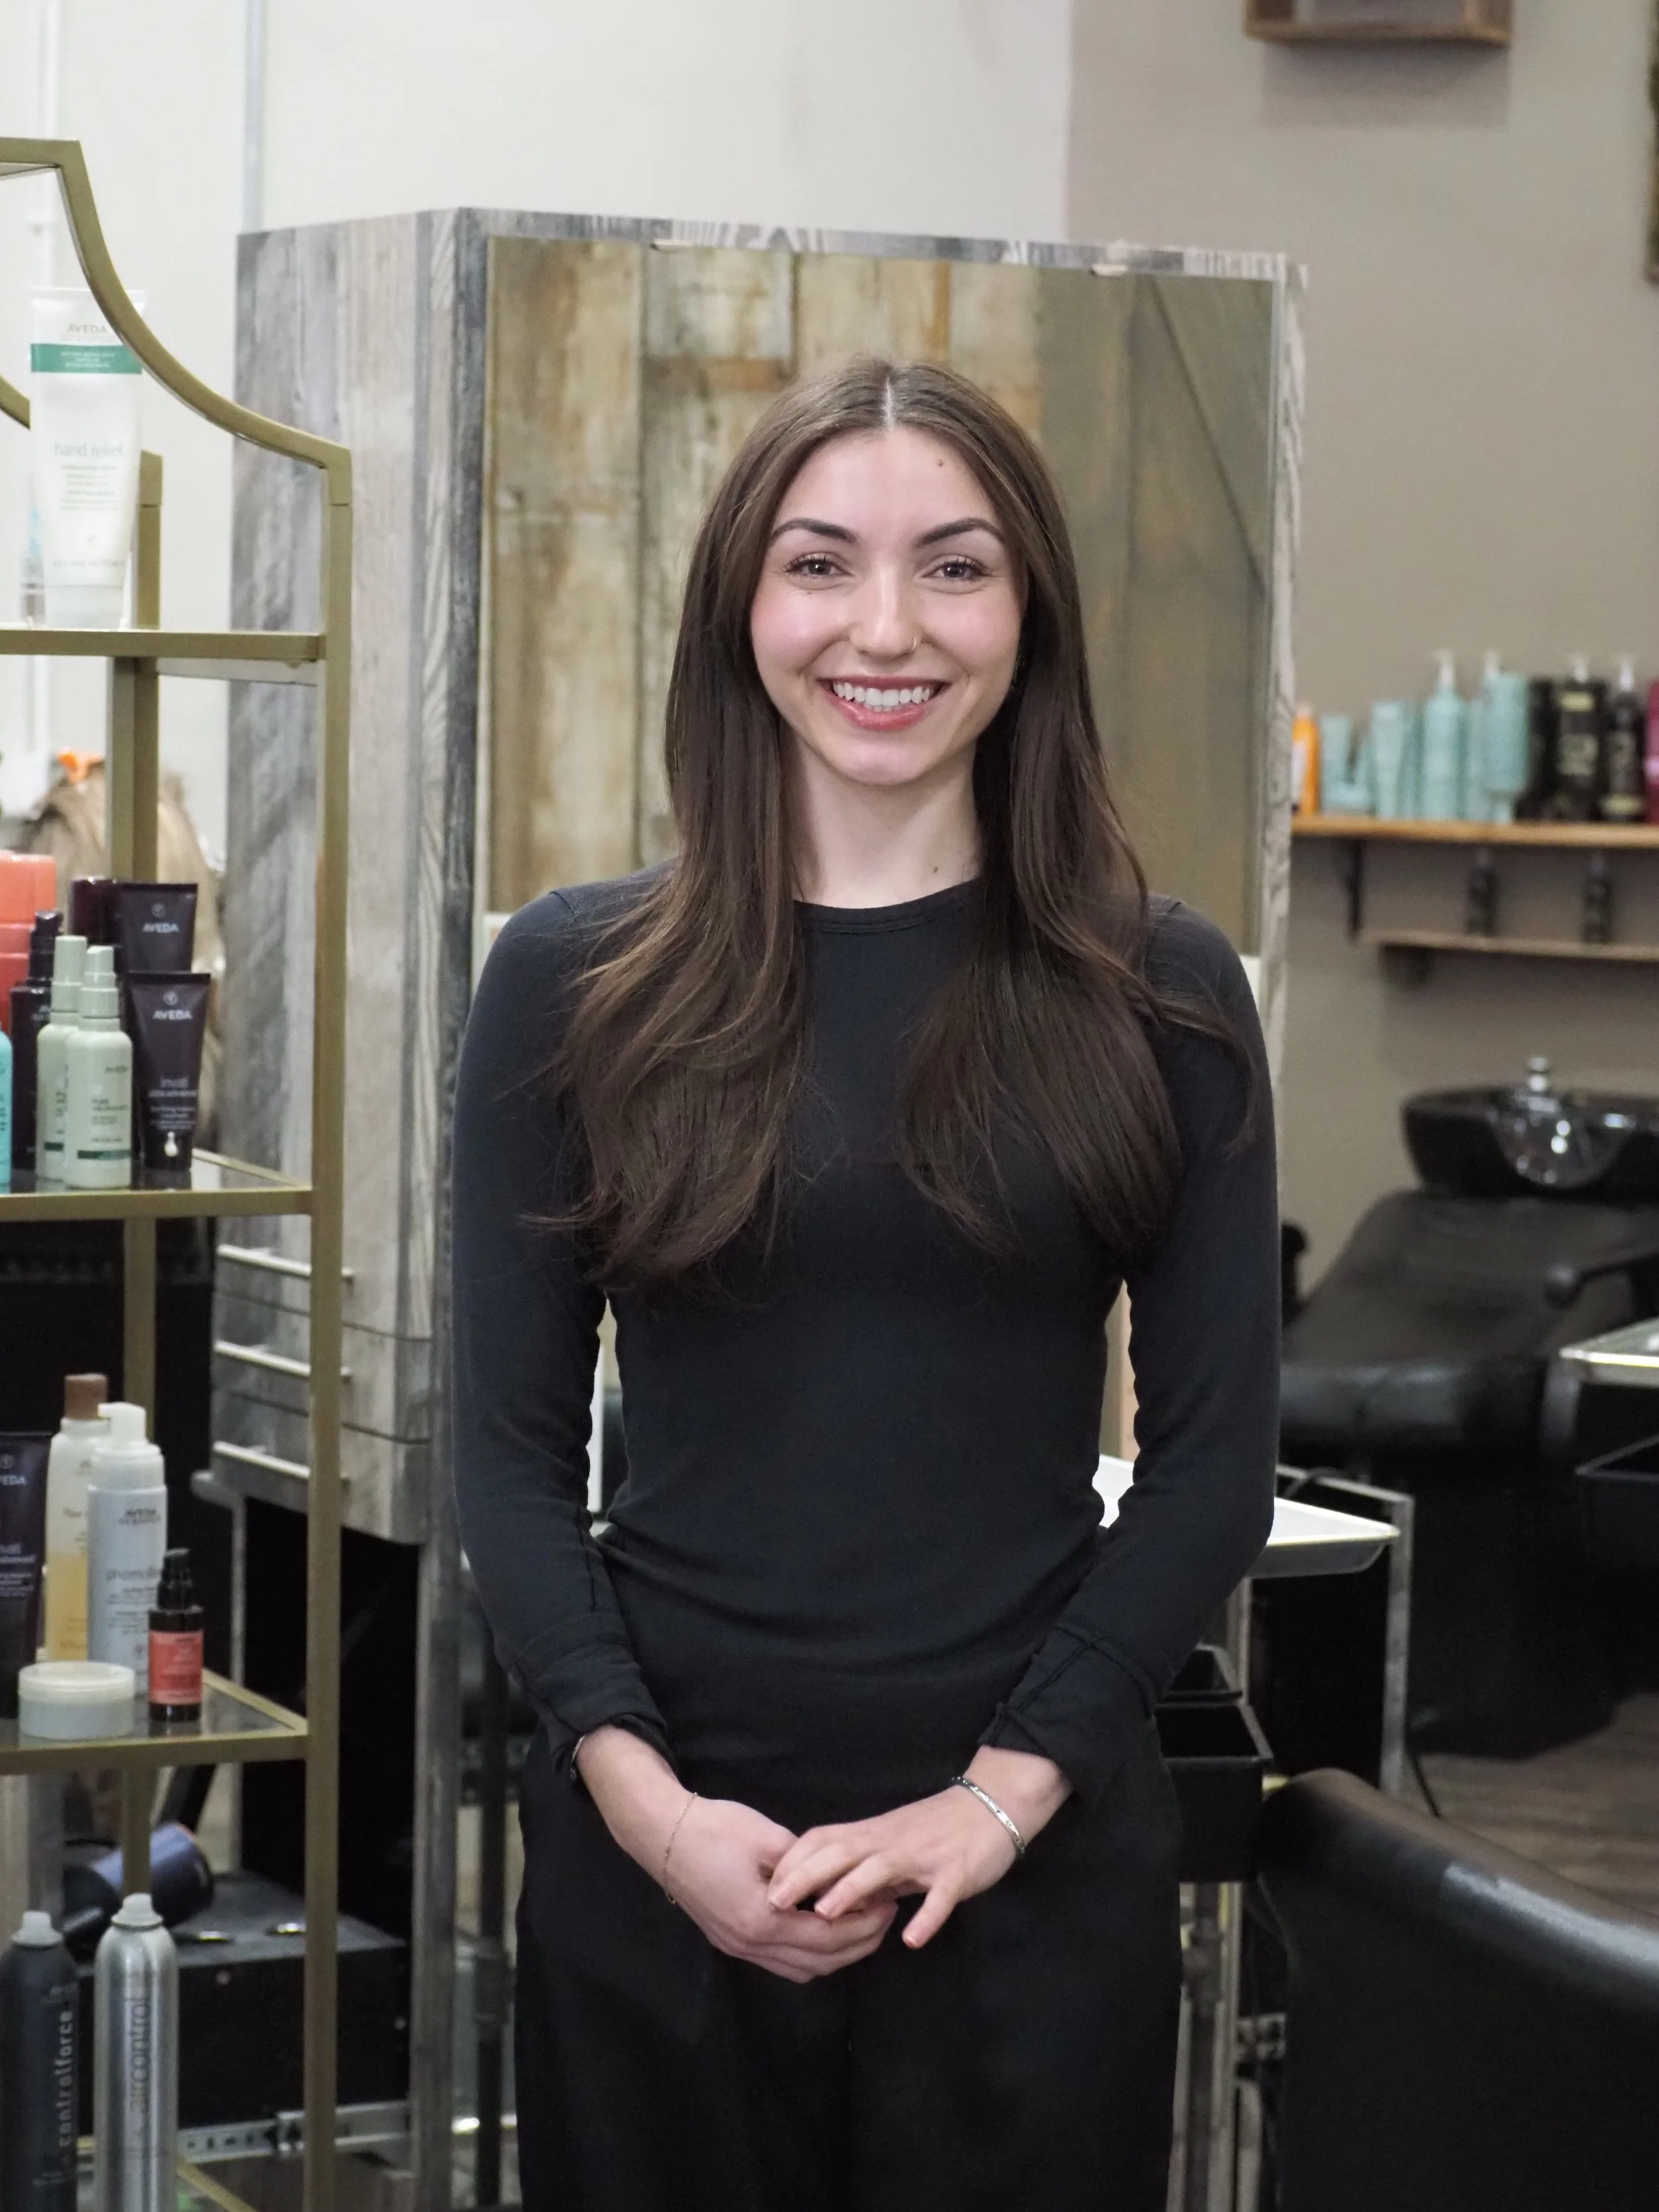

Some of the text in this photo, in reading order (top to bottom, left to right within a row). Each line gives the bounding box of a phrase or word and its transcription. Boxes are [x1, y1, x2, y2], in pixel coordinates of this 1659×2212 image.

[68, 324, 107, 334] AVEDA
[143, 922, 179, 933] AVEDA
[153, 1009, 192, 1020] AVEDA
[0, 1475, 27, 1485] EDA
